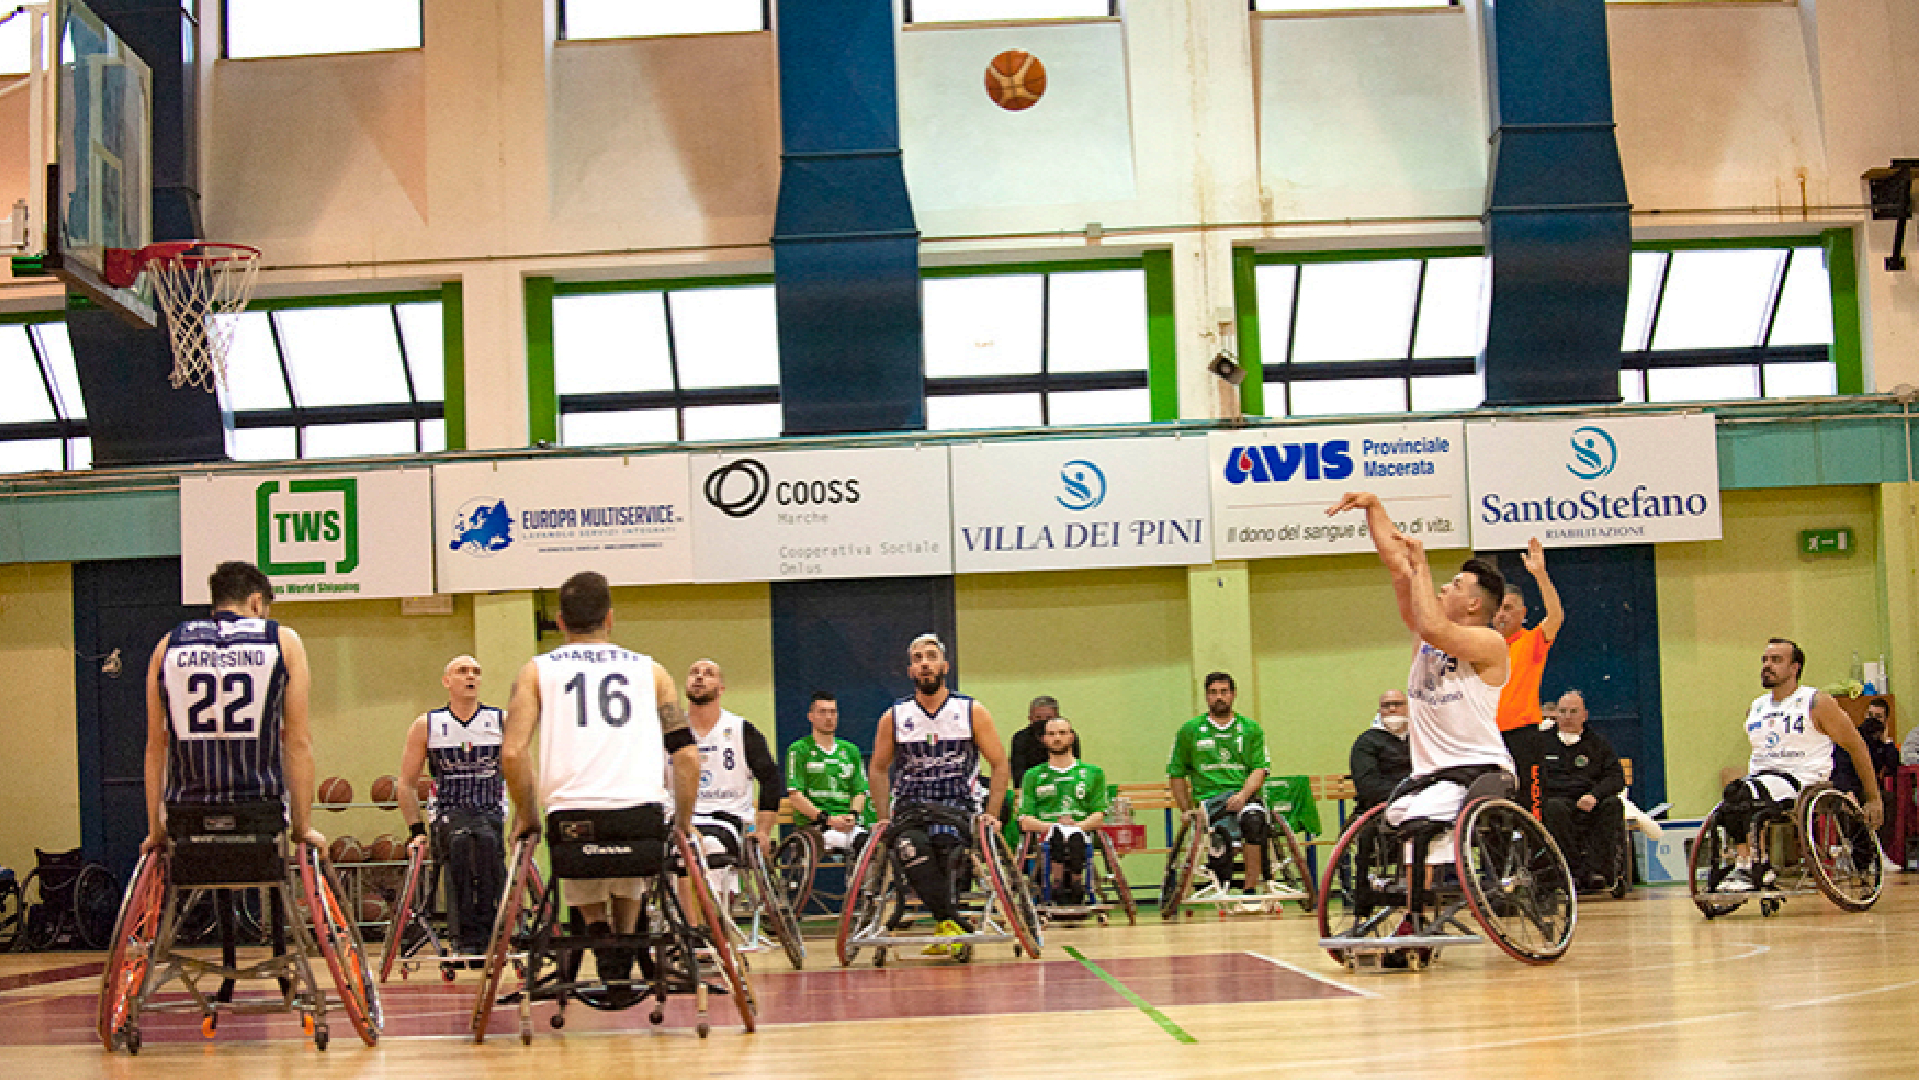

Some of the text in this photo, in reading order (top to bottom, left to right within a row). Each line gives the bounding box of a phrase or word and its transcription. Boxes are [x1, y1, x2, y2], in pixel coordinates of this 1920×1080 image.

[1362, 436, 1450, 455] Provinciale
[1224, 440, 1354, 485] AVIS
[1363, 460, 1435, 477] Macerata
[776, 478, 860, 505] COOSS
[1481, 484, 1708, 525] SantoStefano
[273, 509, 341, 544] TWS
[522, 504, 674, 530] EUROPA MULTISERVICE
[777, 511, 828, 525] Marche
[960, 517, 1203, 552] VILLA DEI PINI
[1227, 526, 1237, 543] Il
[1238, 525, 1275, 543] dono
[1277, 524, 1300, 541] del
[1304, 525, 1356, 543] sangue
[1409, 517, 1423, 534] di
[1426, 515, 1455, 533] vita.
[1545, 526, 1646, 539] RIABILITAZIONE
[779, 539, 940, 560] Cooperativa Sociale
[285, 582, 315, 594] World
[316, 582, 361, 595] Shipping
[187, 673, 255, 734] 22
[564, 672, 632, 728] 16
[441, 723, 449, 736] 1
[903, 716, 915, 732] 4
[1783, 713, 1804, 734] 14
[1236, 736, 1244, 753] 1
[722, 747, 736, 770] 8
[1075, 781, 1086, 800] 6
